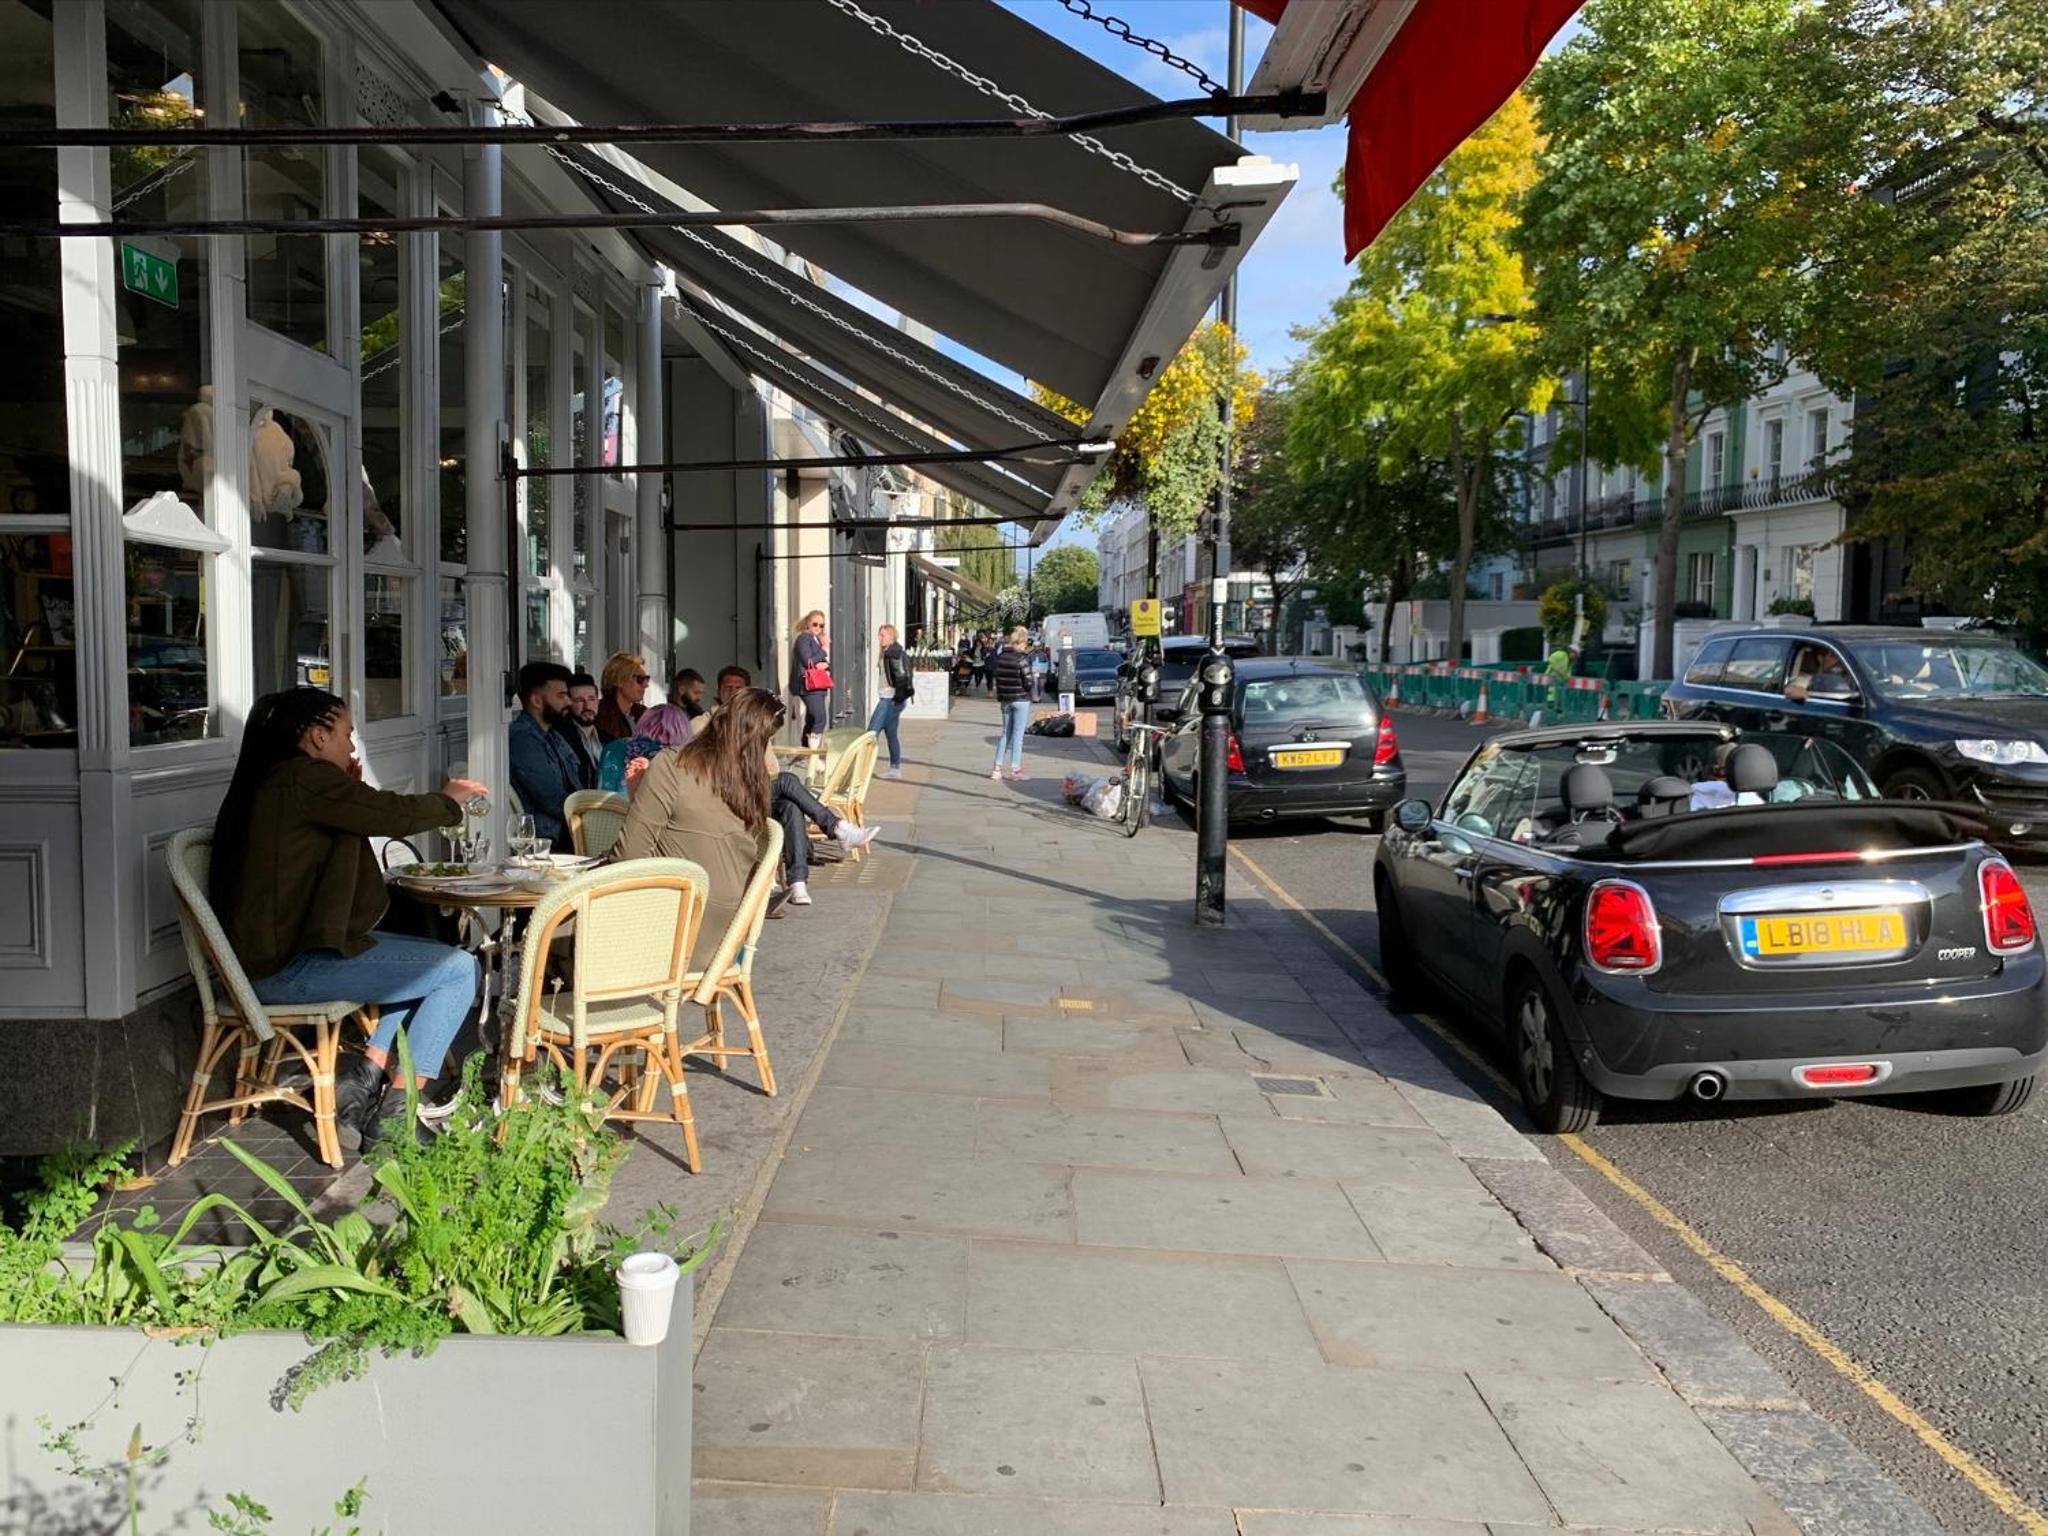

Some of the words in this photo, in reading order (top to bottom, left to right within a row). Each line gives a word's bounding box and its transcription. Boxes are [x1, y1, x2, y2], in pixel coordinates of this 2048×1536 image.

[1768, 919, 1830, 948] LB18
[1839, 917, 1894, 944] HLA
[1938, 947, 1976, 961] COOPER
